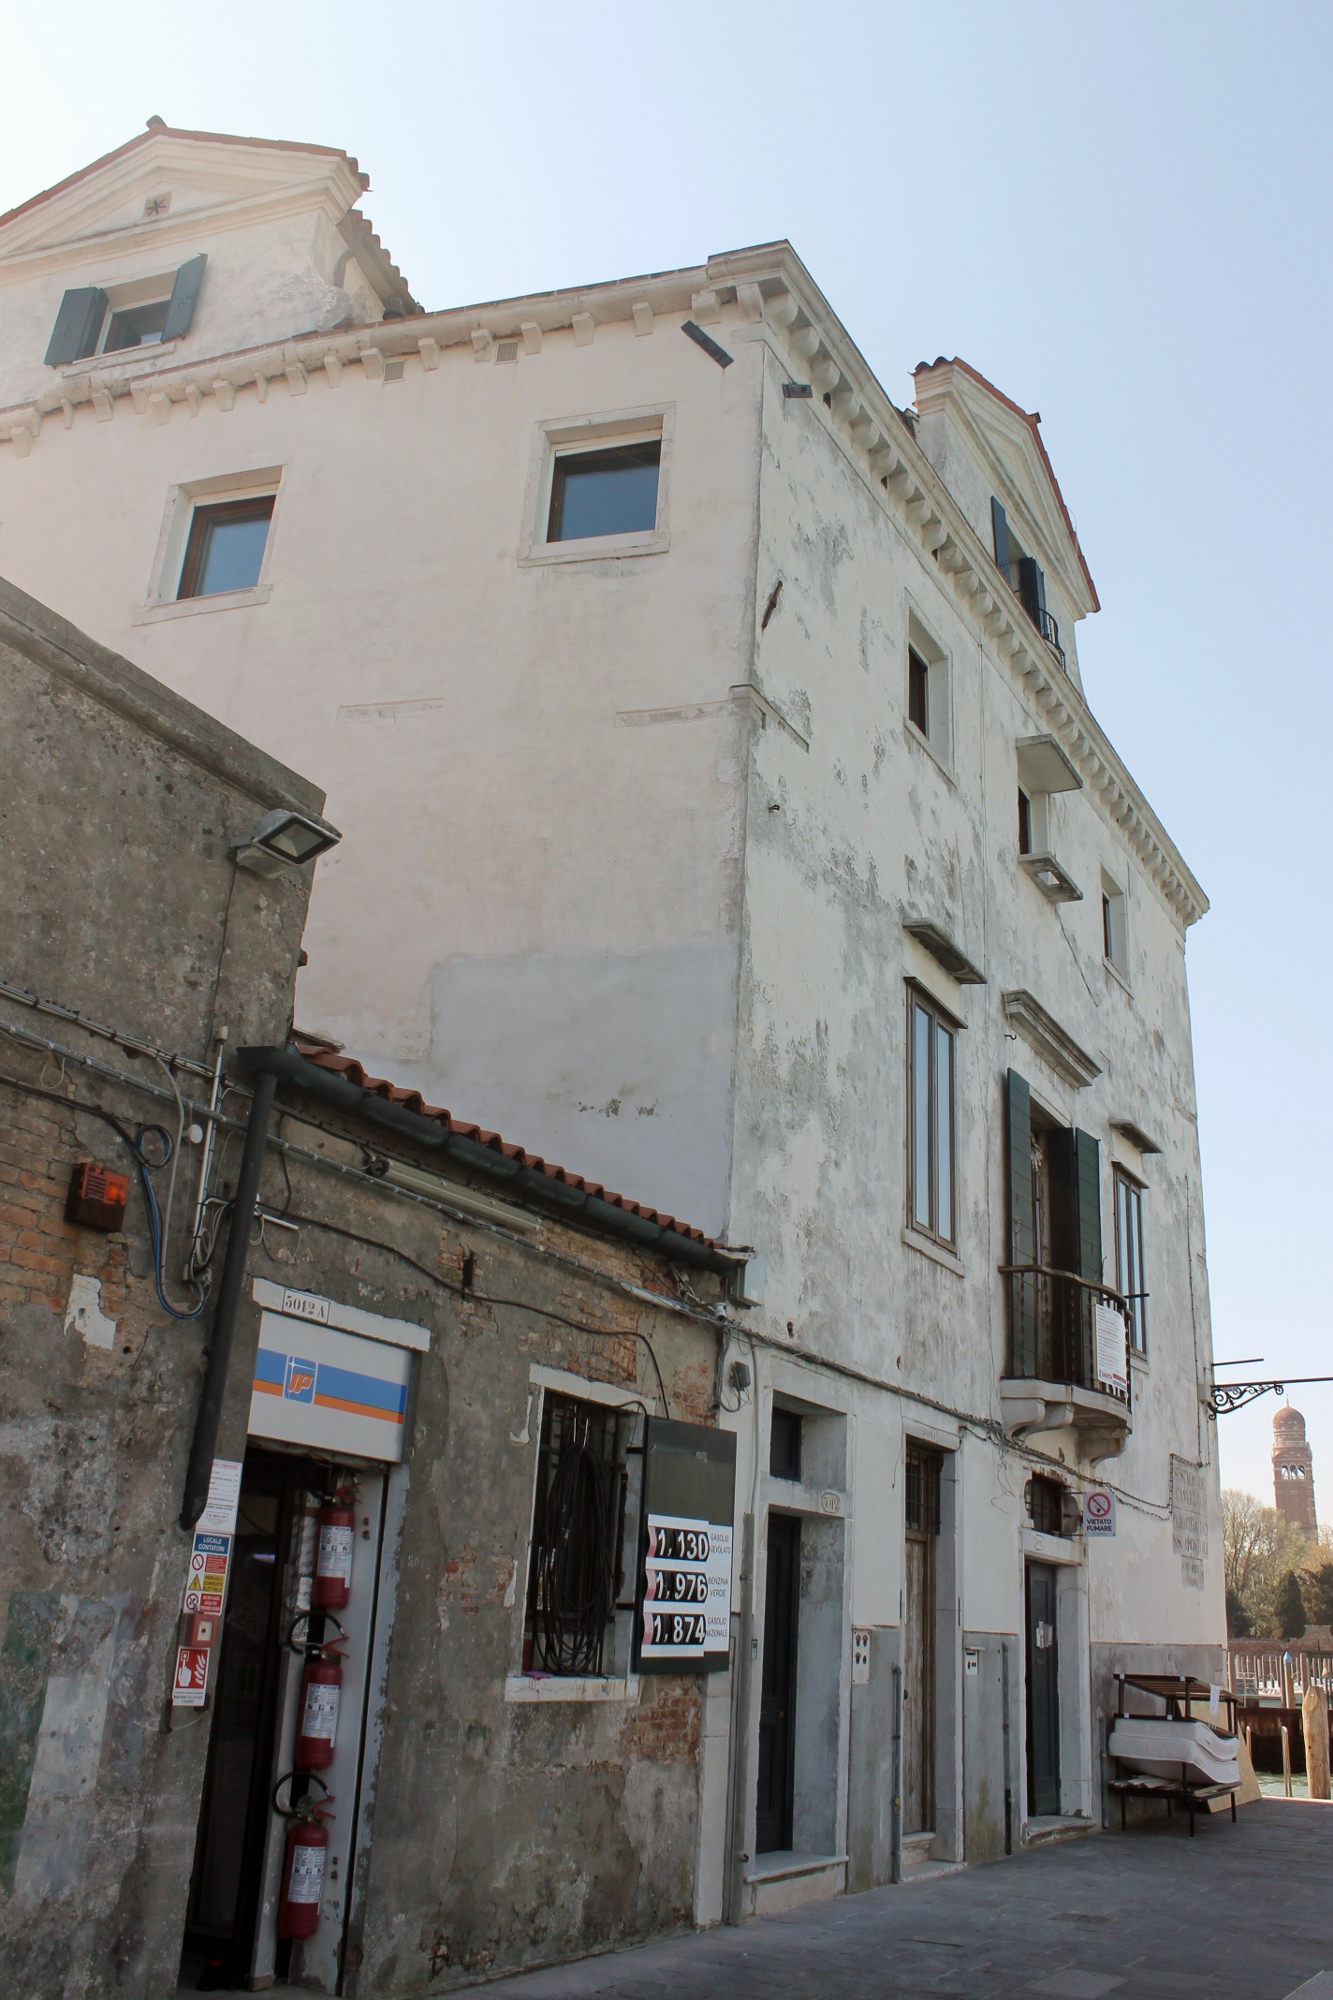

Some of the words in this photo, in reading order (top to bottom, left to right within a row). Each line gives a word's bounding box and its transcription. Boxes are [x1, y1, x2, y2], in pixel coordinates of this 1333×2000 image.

[285, 1295, 315, 1315] 5012
[317, 1304, 325, 1318] A
[710, 1532, 730, 1542] GASOLIO
[198, 1543, 226, 1552] CONTATORI
[658, 1528, 709, 1561] 1,130
[708, 1576, 729, 1586] BENZINA
[656, 1571, 707, 1602] 1,976
[709, 1588, 726, 1598] VERDE
[707, 1617, 727, 1626] GASOLIO
[654, 1614, 705, 1644] 1,874
[706, 1628, 728, 1638] NAZIONALE
